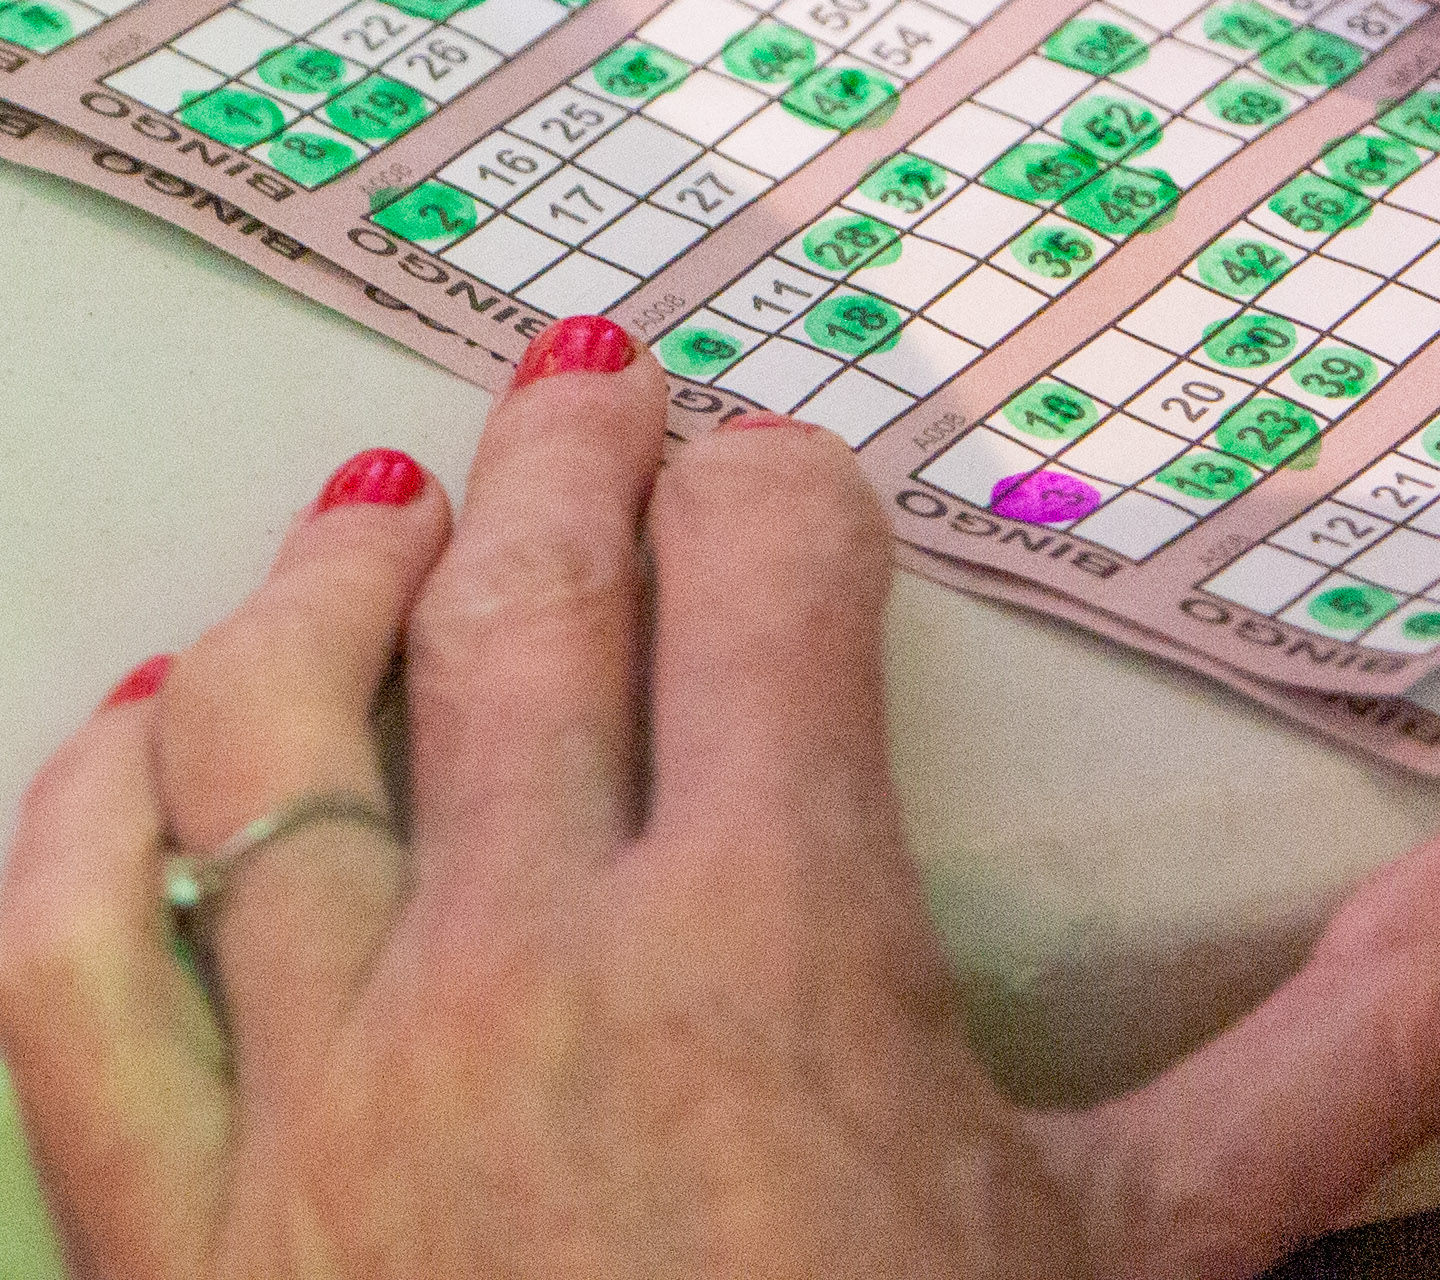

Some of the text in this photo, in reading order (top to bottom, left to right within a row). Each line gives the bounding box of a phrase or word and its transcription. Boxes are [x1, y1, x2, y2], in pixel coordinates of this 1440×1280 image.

[222, 103, 264, 128] 1
[279, 56, 340, 86] 15
[341, 16, 407, 53] 22
[281, 137, 329, 162] 8
[350, 91, 411, 127] 19
[405, 41, 470, 82] 26
[548, 183, 605, 226] 17
[750, 43, 807, 81] 44
[675, 171, 735, 215] 27
[812, 69, 872, 118] 47
[871, 26, 933, 67] 54
[79, 91, 296, 202] BINGO
[418, 103, 605, 232] 2 16 25
[690, 24, 1138, 361] 9 11 28 32 64
[826, 304, 889, 343] 18
[1084, 106, 1150, 150] 52
[1217, 10, 1270, 48] 74
[1028, 231, 1093, 279] 35
[1098, 185, 1157, 226] 48
[1280, 46, 1348, 81] 75
[1345, 0, 1402, 39] 87
[92, 148, 308, 261] BINGO
[1024, 393, 1086, 434] 10
[1221, 243, 1283, 286] 42
[1279, 192, 1346, 233] 56
[1343, 146, 1406, 185] 61
[1160, 380, 1227, 424] 20
[1225, 325, 1291, 366] 30
[1174, 461, 1238, 497] 13
[1235, 409, 1303, 454] 23
[1300, 356, 1366, 399] 39
[895, 490, 1120, 580] BINGO
[1309, 515, 1375, 548] 12
[1369, 472, 1434, 511] 21
[1326, 587, 1374, 618] 5
